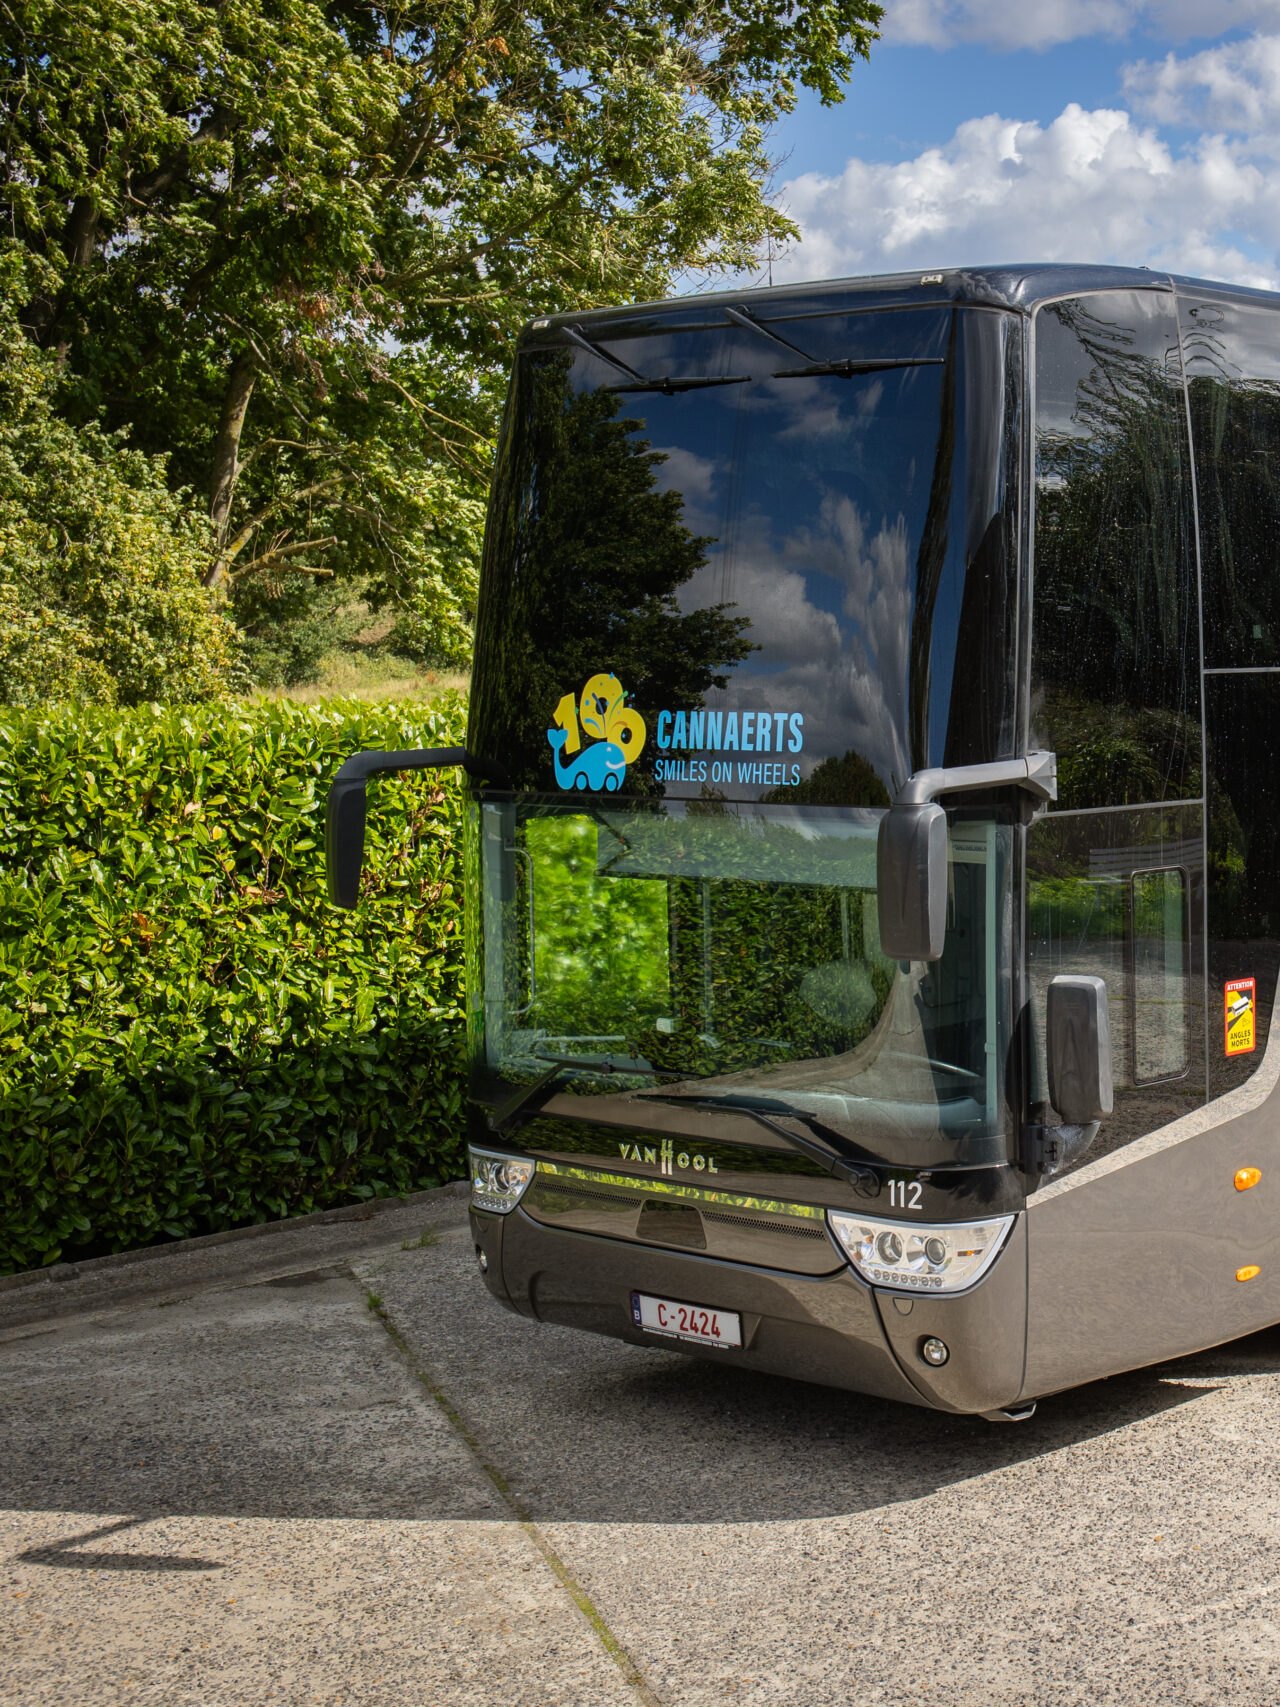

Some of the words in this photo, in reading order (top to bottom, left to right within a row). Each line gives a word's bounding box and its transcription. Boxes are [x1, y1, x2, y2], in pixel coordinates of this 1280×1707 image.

[656, 709, 804, 753] CANNAERTS
[655, 759, 707, 782] SMILES
[712, 761, 732, 783] ON
[738, 762, 801, 786] WHEELS
[1227, 980, 1253, 991] ATTENTION
[1230, 1029, 1251, 1040] ANGLES
[1231, 1038, 1250, 1048] MORTS
[887, 1179, 923, 1210] 112
[633, 1309, 641, 1321] B
[657, 1303, 721, 1338] C-2424
